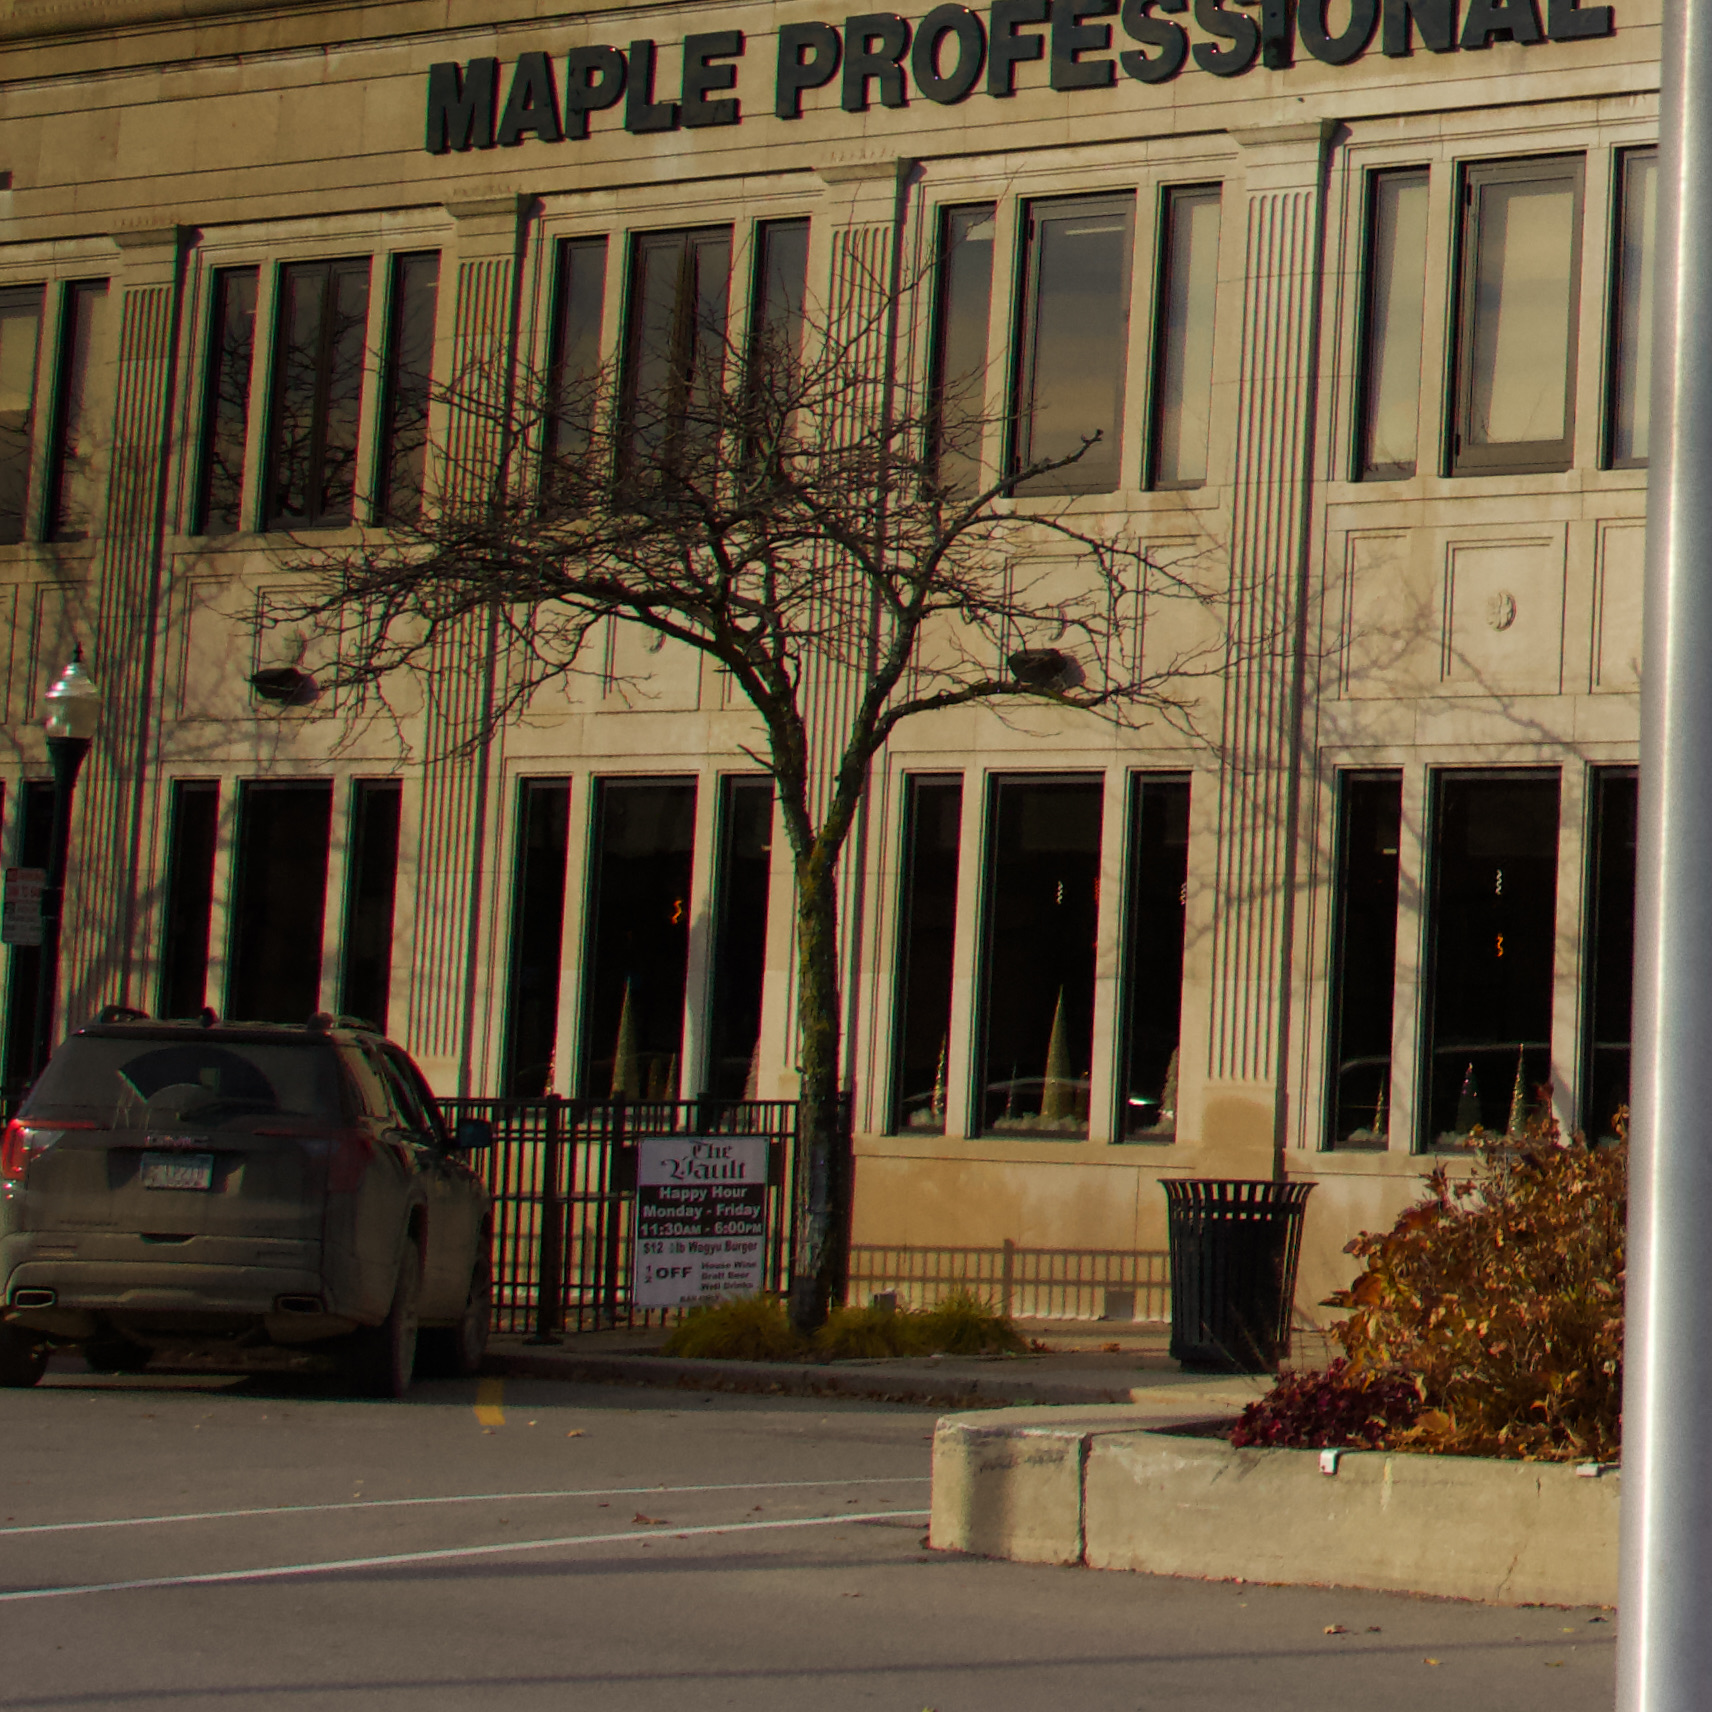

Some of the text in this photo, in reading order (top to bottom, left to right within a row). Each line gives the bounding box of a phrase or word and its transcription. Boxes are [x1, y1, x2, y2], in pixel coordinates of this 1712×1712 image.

[425, 29, 746, 155] MAPLE
[690, 1140, 732, 1159] The
[661, 1156, 746, 1180] Vault
[659, 1185, 748, 1202] Happy Hour
[643, 1204, 703, 1219] Monday
[716, 1203, 761, 1218] Friday
[644, 1241, 664, 1254] $12
[689, 1241, 722, 1255] Wagyu
[725, 1240, 757, 1254] Burger
[656, 1266, 692, 1279] OFF
